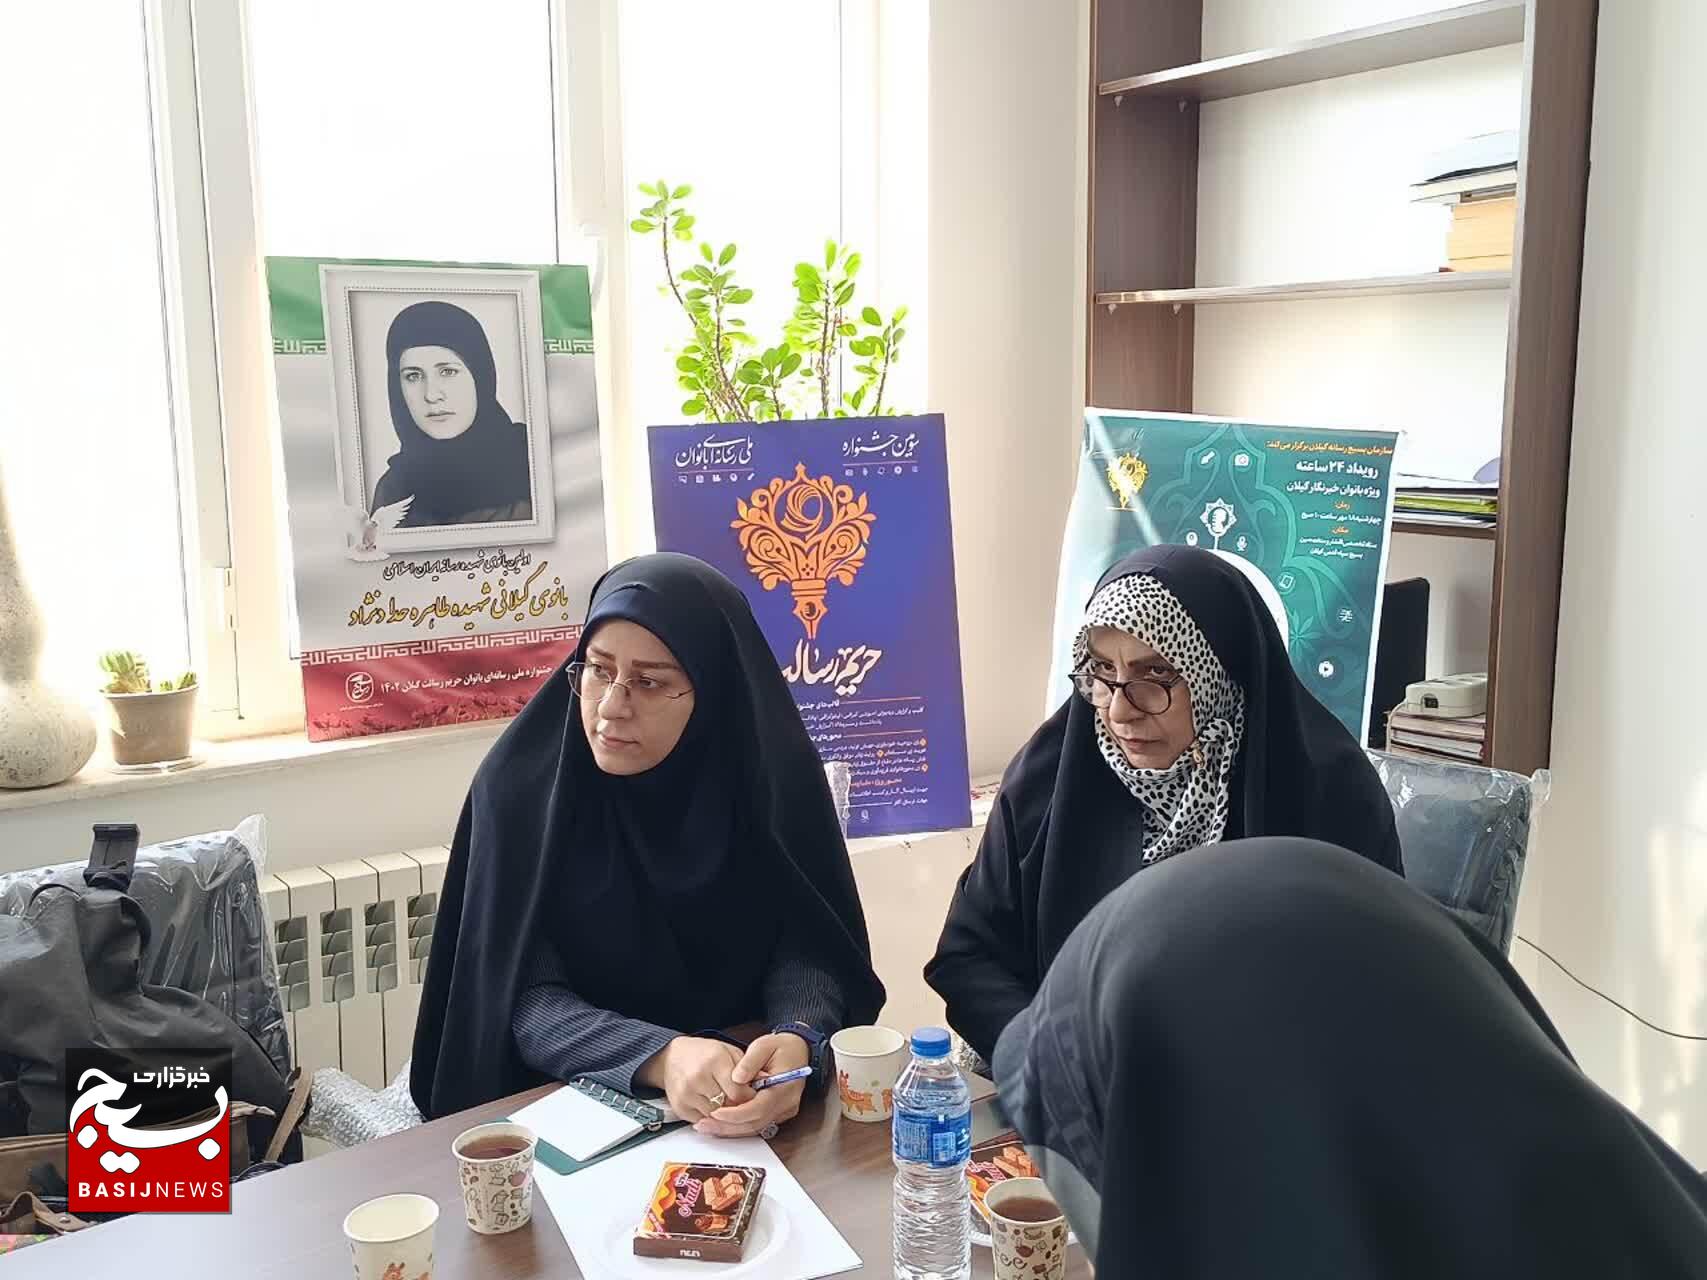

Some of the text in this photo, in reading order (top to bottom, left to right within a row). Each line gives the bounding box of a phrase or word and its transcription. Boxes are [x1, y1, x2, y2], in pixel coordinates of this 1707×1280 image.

[738, 434, 753, 464] ملی
[842, 430, 920, 458] سومین جشنواره
[675, 443, 708, 470] بانوان
[1295, 460, 1379, 479] رویداد ۲۴ ساعته
[1286, 481, 1380, 498] ویژه بانوان خبرنگار گیلان
[383, 560, 415, 580] اسلامی
[414, 560, 441, 582] ایران
[483, 549, 508, 577] بانوی
[490, 561, 548, 621] گیلانی
[528, 577, 569, 621] بانوی
[409, 595, 450, 629] طاهره
[450, 581, 491, 631] شهیده
[463, 671, 484, 686] بانوان
[511, 669, 525, 680] ملی
[525, 665, 553, 677] جشنواره
[834, 644, 882, 696] حریم
[401, 679, 420, 693] گیلان
[421, 677, 445, 689] رسالت
[444, 676, 463, 689] حریم
